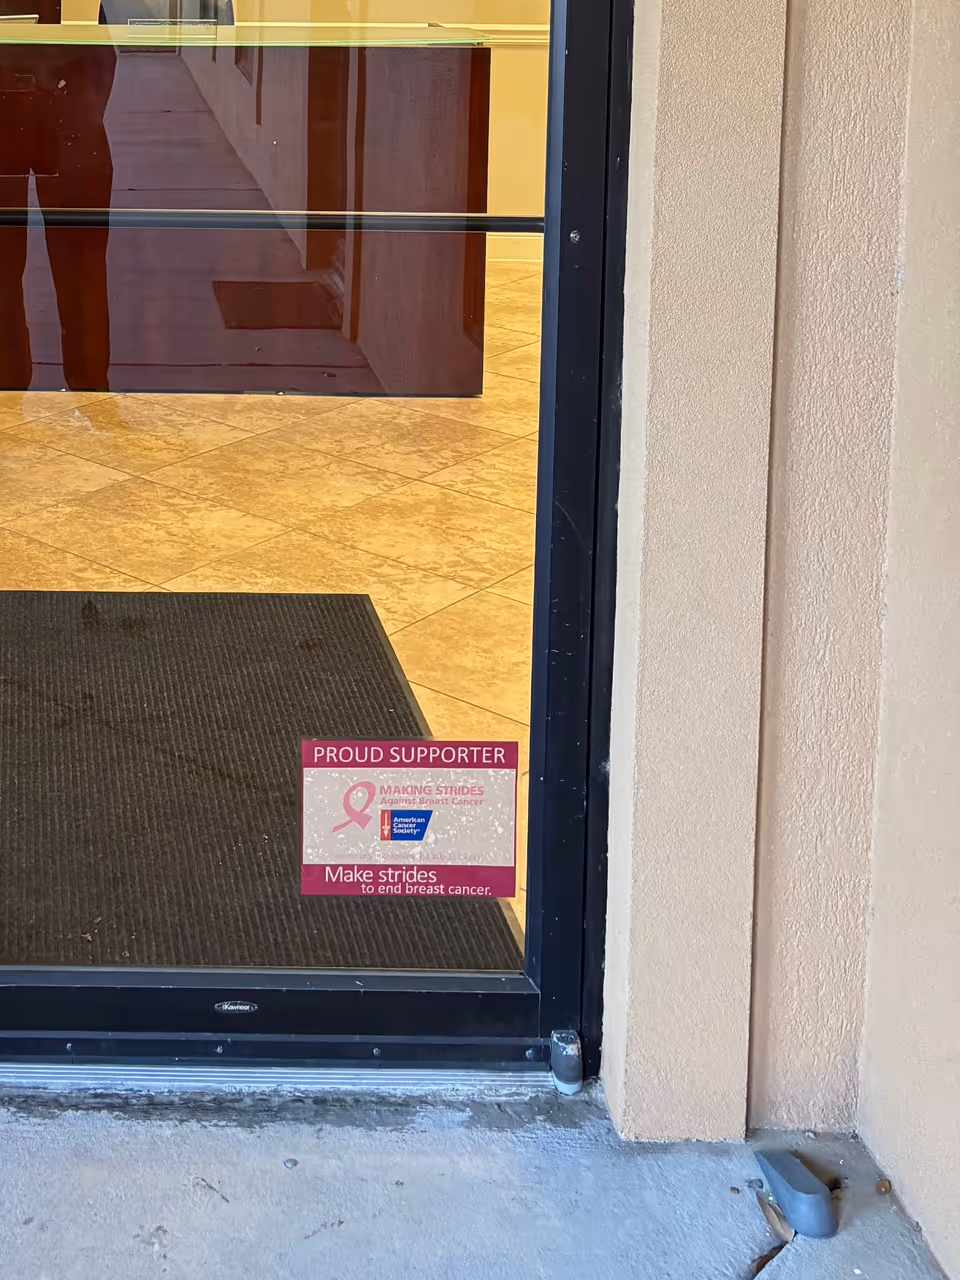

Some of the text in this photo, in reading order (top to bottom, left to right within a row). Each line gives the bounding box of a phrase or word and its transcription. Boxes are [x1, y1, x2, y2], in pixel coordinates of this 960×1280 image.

[313, 746, 506, 764] PROUD SUPPORTER
[380, 785, 484, 796] MAKING STRIDES
[380, 797, 483, 807] Against Breast Cancer
[324, 865, 437, 883] Make strides
[361, 882, 492, 896] to end breast cancer.
